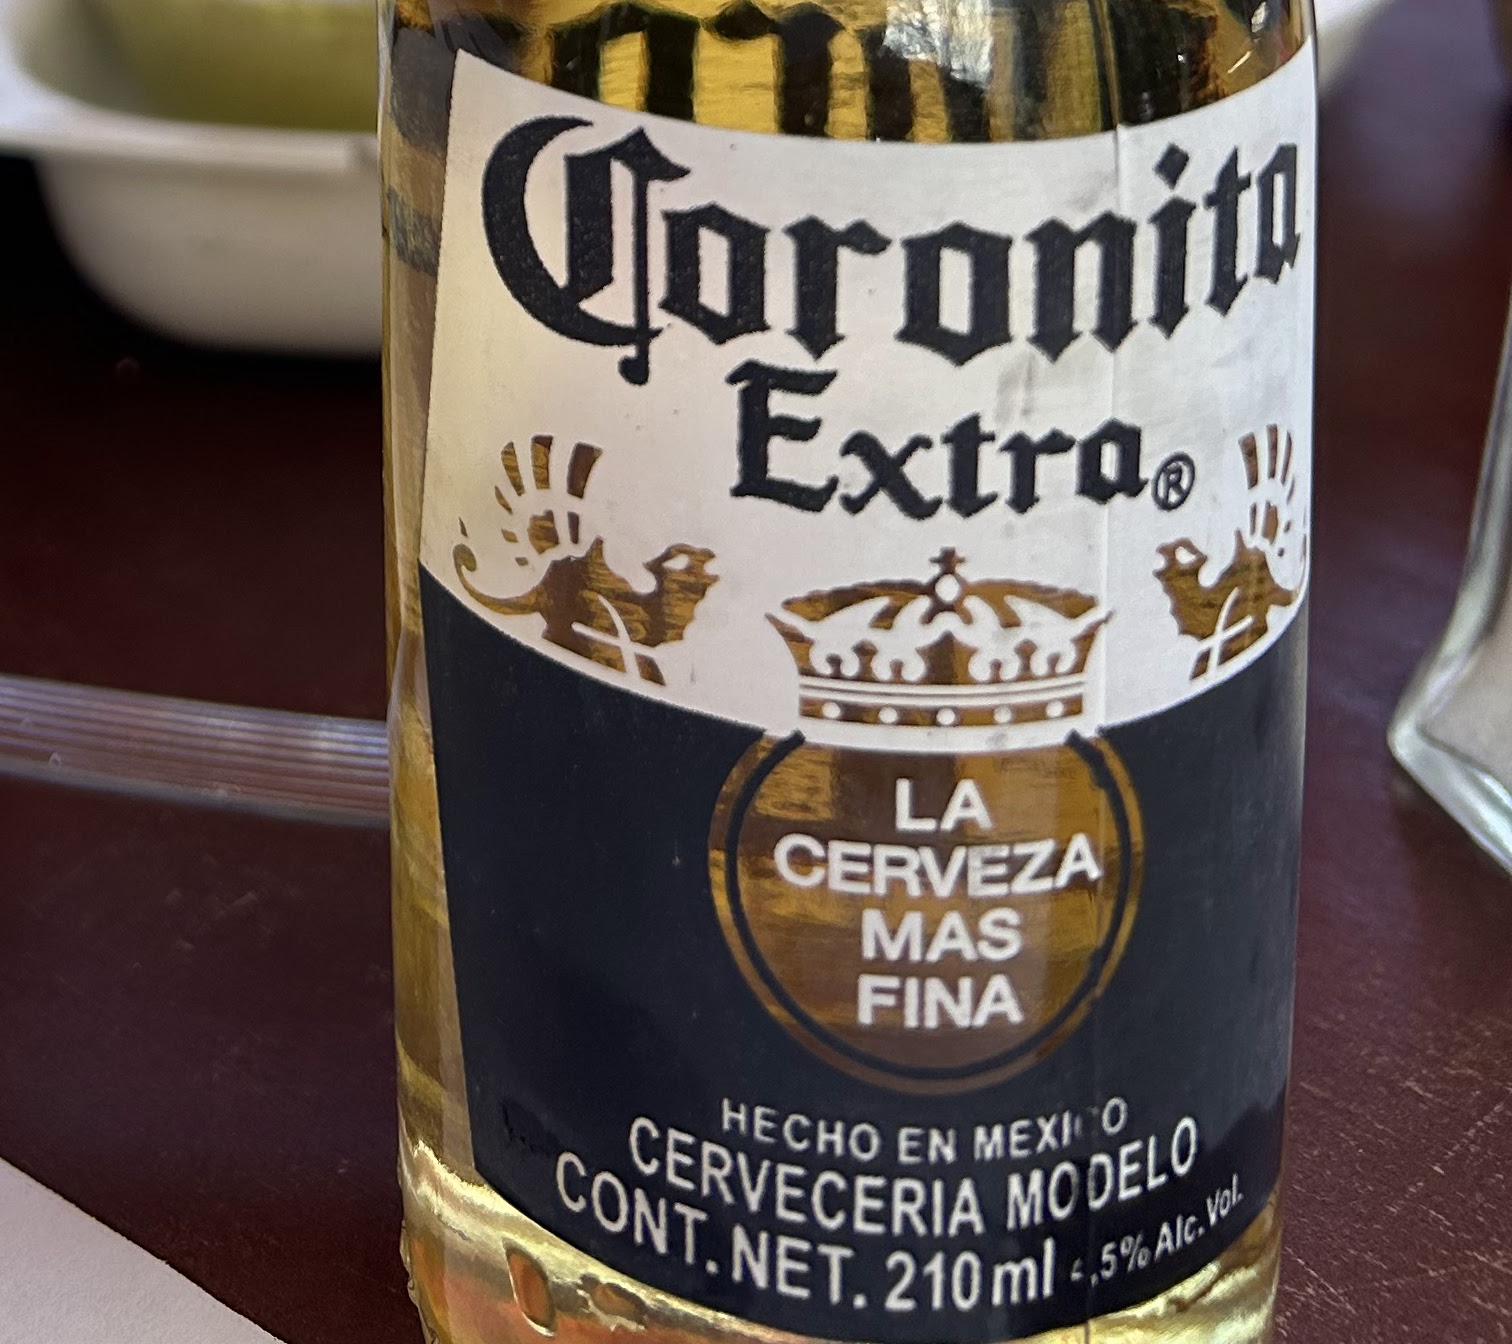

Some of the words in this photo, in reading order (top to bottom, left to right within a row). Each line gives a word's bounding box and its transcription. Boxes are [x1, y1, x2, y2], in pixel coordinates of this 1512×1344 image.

[481, 115, 1300, 385] Coronita
[895, 777, 992, 832] LA
[773, 832, 1103, 898] CERVEZA
[861, 907, 1024, 963] MAS
[857, 972, 1025, 1029] FINA
[720, 1098, 882, 1162] HECHO
[898, 1126, 957, 1164] EN
[974, 1097, 1128, 1161] MEXIO
[628, 1116, 986, 1238] CERVECERIA
[1006, 1116, 1197, 1231] MODELO
